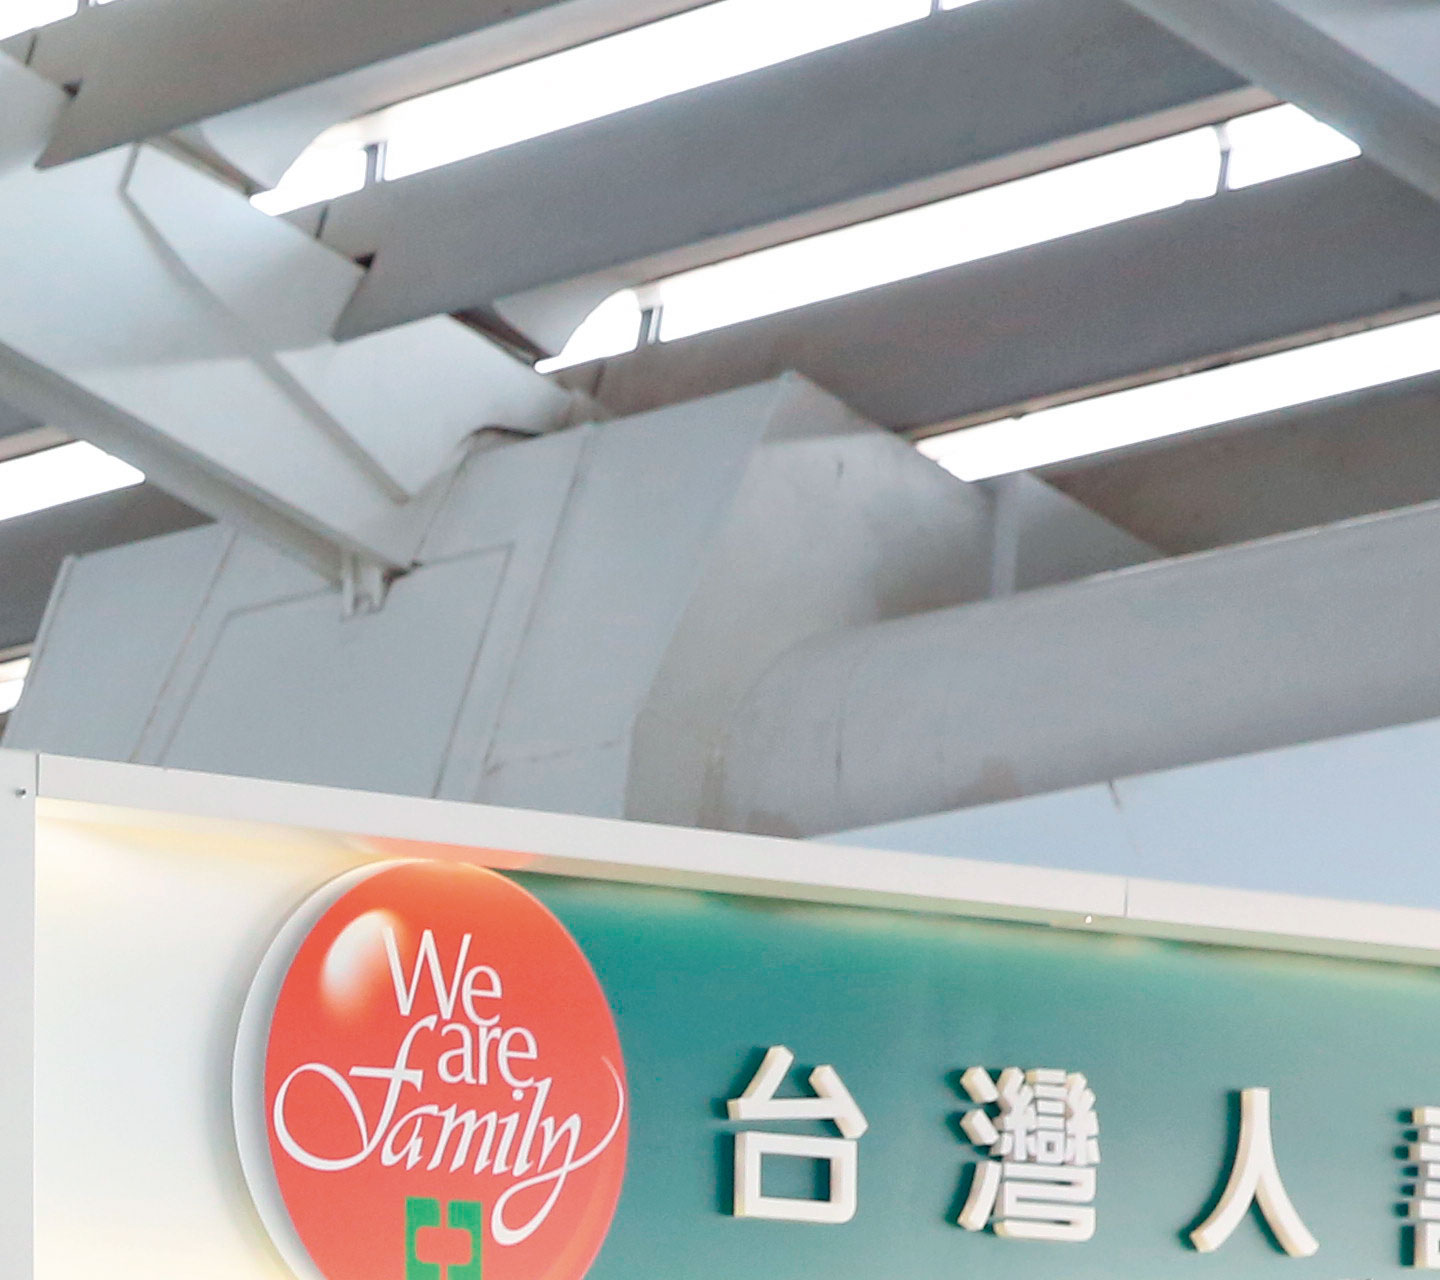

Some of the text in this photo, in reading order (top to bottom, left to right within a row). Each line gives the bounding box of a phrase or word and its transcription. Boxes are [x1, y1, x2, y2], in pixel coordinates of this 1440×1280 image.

[383, 928, 503, 1027] We
[437, 1022, 538, 1089] are
[273, 1014, 624, 1245] Family
